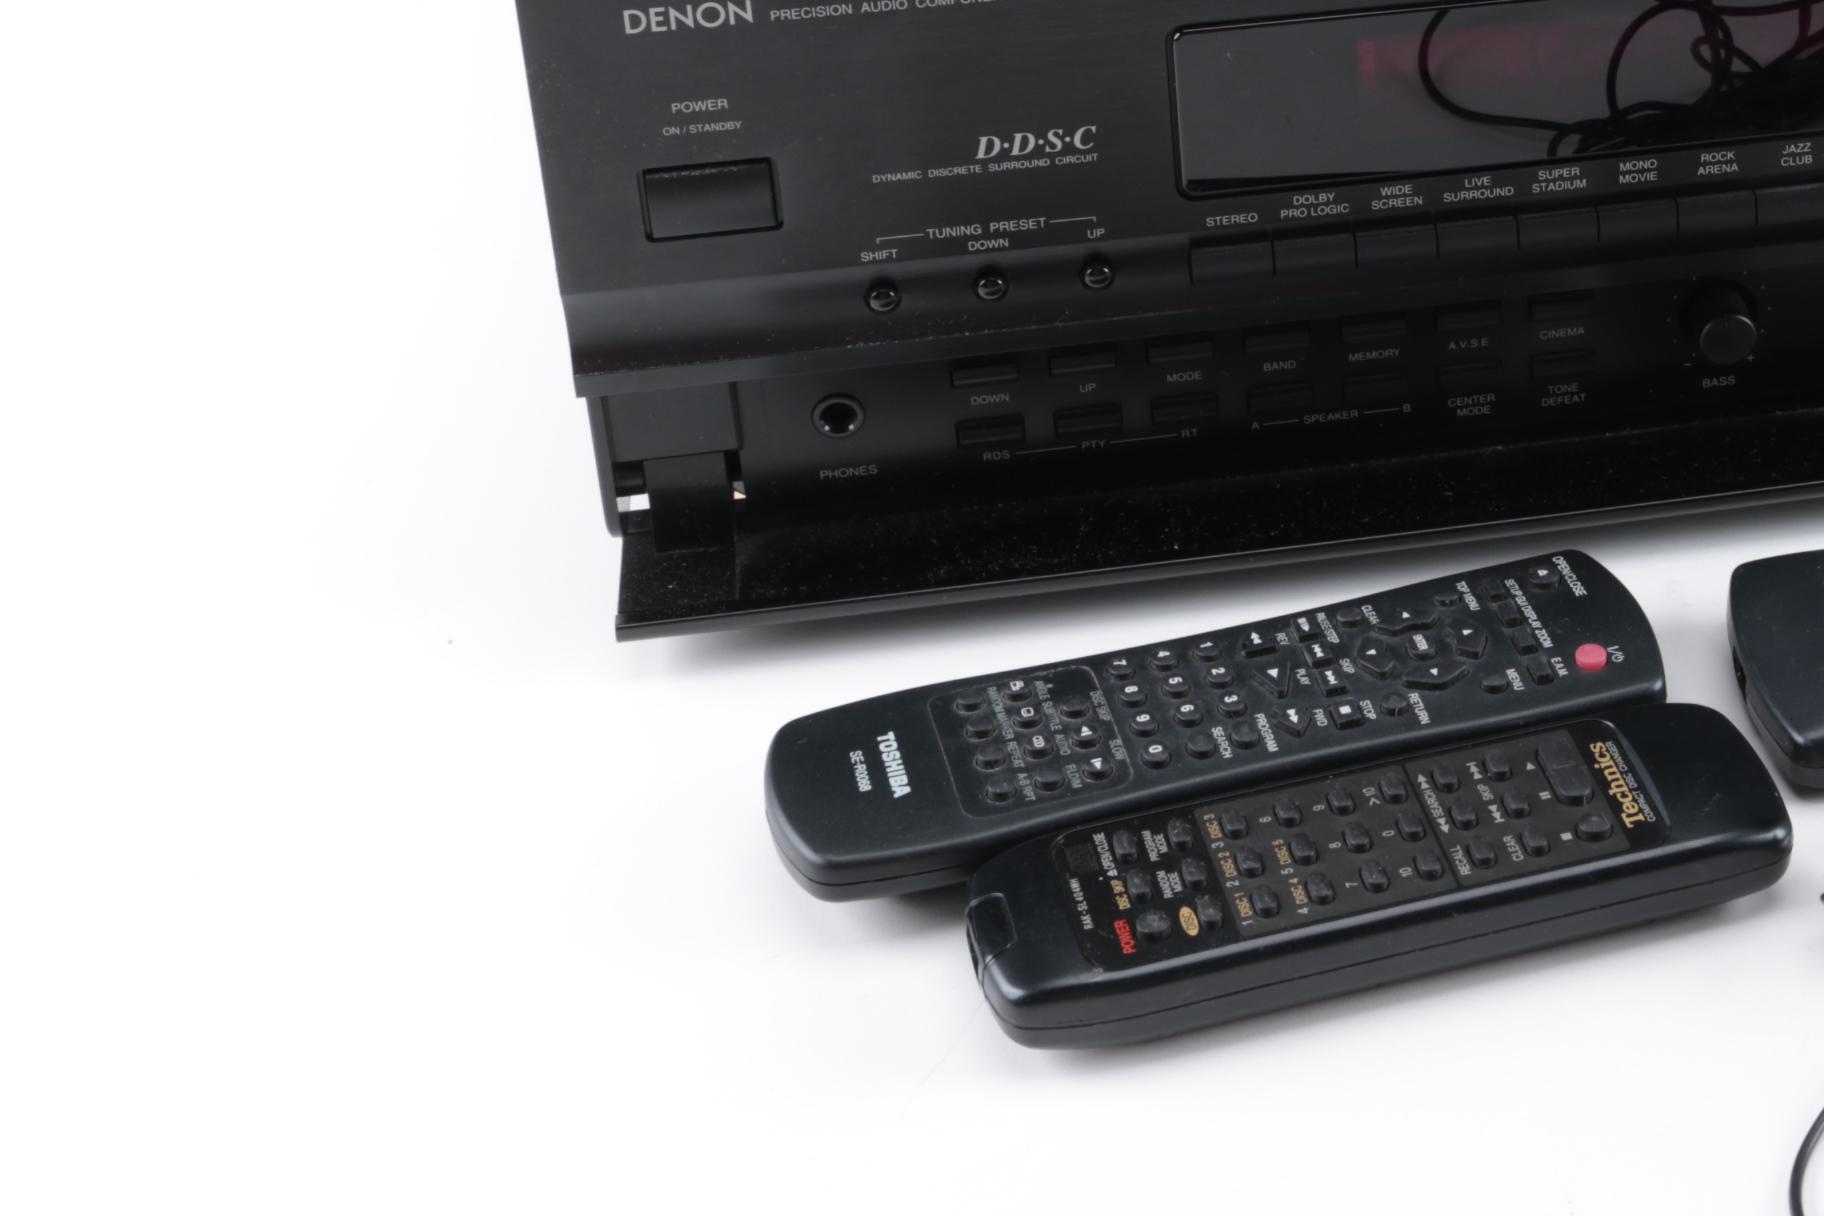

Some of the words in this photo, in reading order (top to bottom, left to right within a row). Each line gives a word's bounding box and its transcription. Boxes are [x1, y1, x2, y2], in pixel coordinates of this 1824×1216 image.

[622, 0, 754, 34] DENON
[770, 3, 852, 22] PRECISION
[671, 98, 728, 114] POWER
[663, 127, 681, 136] ON
[689, 120, 743, 134] STANDBY
[1782, 142, 1811, 155] JAZZ
[1700, 150, 1736, 164] ROCK
[1780, 154, 1813, 167] CLUB
[872, 170, 922, 184] DYNAMIC
[928, 164, 982, 178] DISCRETE
[988, 157, 1050, 173] SURROUND
[1055, 153, 1098, 166] CIRCUIT
[1619, 159, 1658, 172] MONO
[1697, 162, 1739, 176] ARENA
[1538, 167, 1580, 180] SUPER
[1619, 171, 1658, 184] MOVIE
[1465, 176, 1492, 188] LIVE
[1532, 178, 1587, 194] STADIUM
[1379, 184, 1413, 197] WIDE
[1443, 186, 1514, 203] SURROUND
[1293, 192, 1335, 206] DOLBY
[1371, 195, 1424, 210] SCREEN
[1280, 207, 1307, 220] PRO
[1310, 203, 1350, 216] LOGIC
[1206, 212, 1258, 227] STEREO
[925, 224, 982, 240] TUNING
[989, 217, 1047, 233] PRESET
[1087, 228, 1104, 239] UP
[968, 238, 1009, 251] DOWN
[860, 249, 898, 262] SHIFT
[1539, 326, 1585, 340] CINEMA
[1348, 347, 1400, 363] MEMORY
[1263, 359, 1296, 372] BAND
[1166, 371, 1202, 383] MODE
[1702, 375, 1736, 388] BASS
[1079, 383, 1096, 393] UP
[1548, 382, 1578, 395] TONE
[970, 392, 1010, 406] DOWN
[1447, 393, 1495, 408] CENTER
[1541, 393, 1586, 408] DEFEAT
[1303, 409, 1359, 425] SPEAKER
[1456, 405, 1491, 417] MODE
[983, 450, 1010, 462] RDS
[1081, 439, 1107, 450] PTY
[819, 464, 878, 480] PHONES
[1211, 666, 1226, 676] 2
[1148, 744, 1164, 754] 0
[877, 730, 912, 800] TOSHIBA
[1589, 740, 1646, 830] Technics
[1112, 918, 1137, 955] POWER
